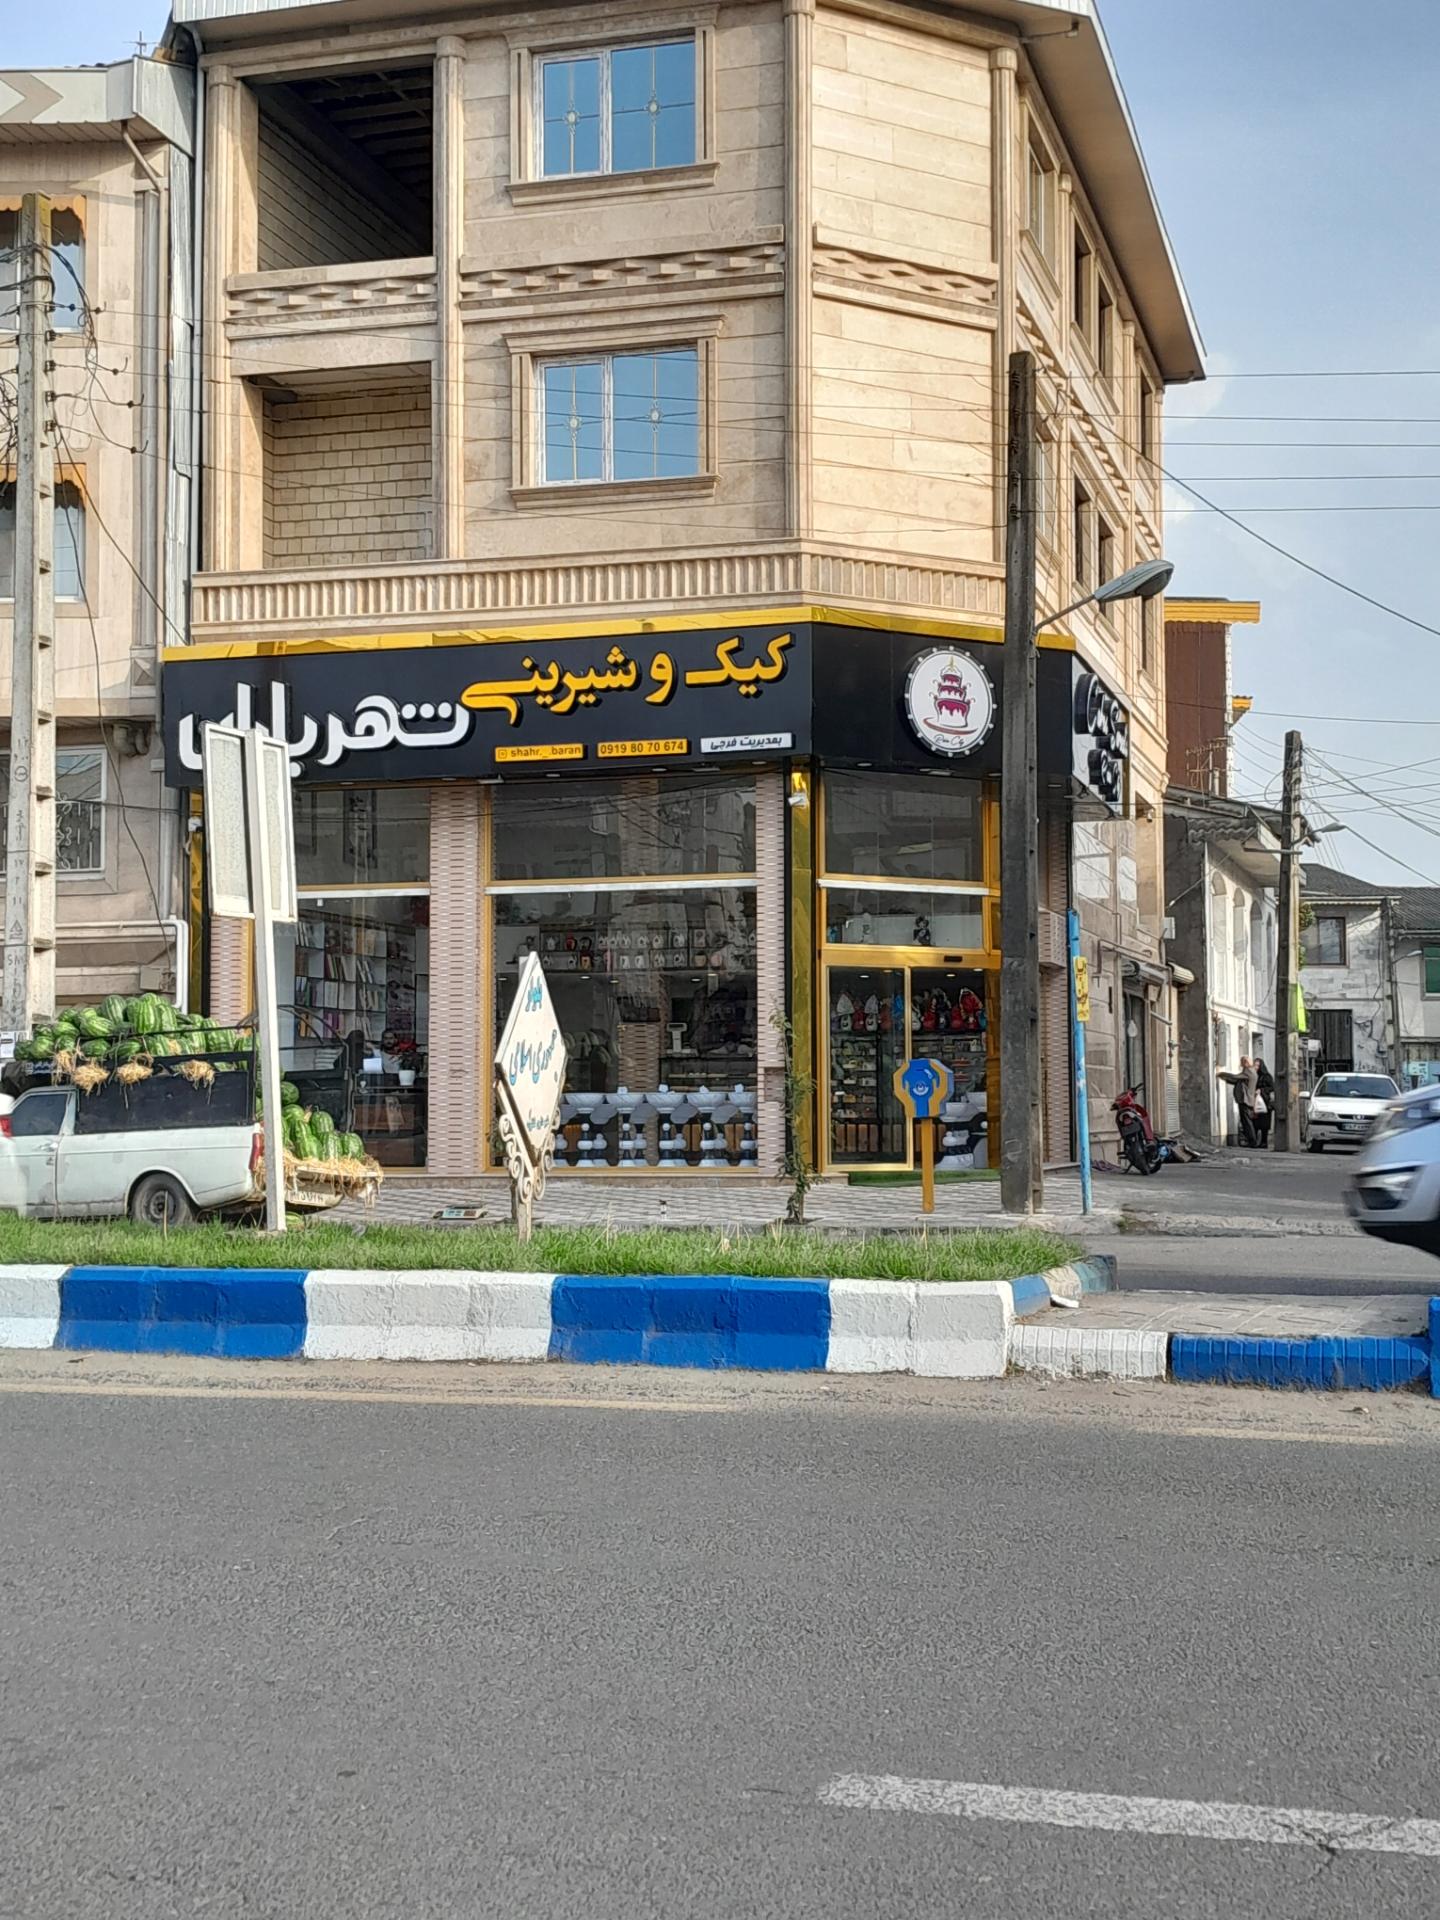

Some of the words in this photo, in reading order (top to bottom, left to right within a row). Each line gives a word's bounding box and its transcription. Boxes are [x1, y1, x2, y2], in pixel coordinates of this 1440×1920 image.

[461, 645, 637, 725] شیرینی
[644, 650, 674, 704] و
[685, 632, 792, 696] کیک
[600, 743, 627, 755] 0919
[630, 742, 644, 753] 80
[647, 741, 661, 752] 70
[663, 740, 684, 752] 674
